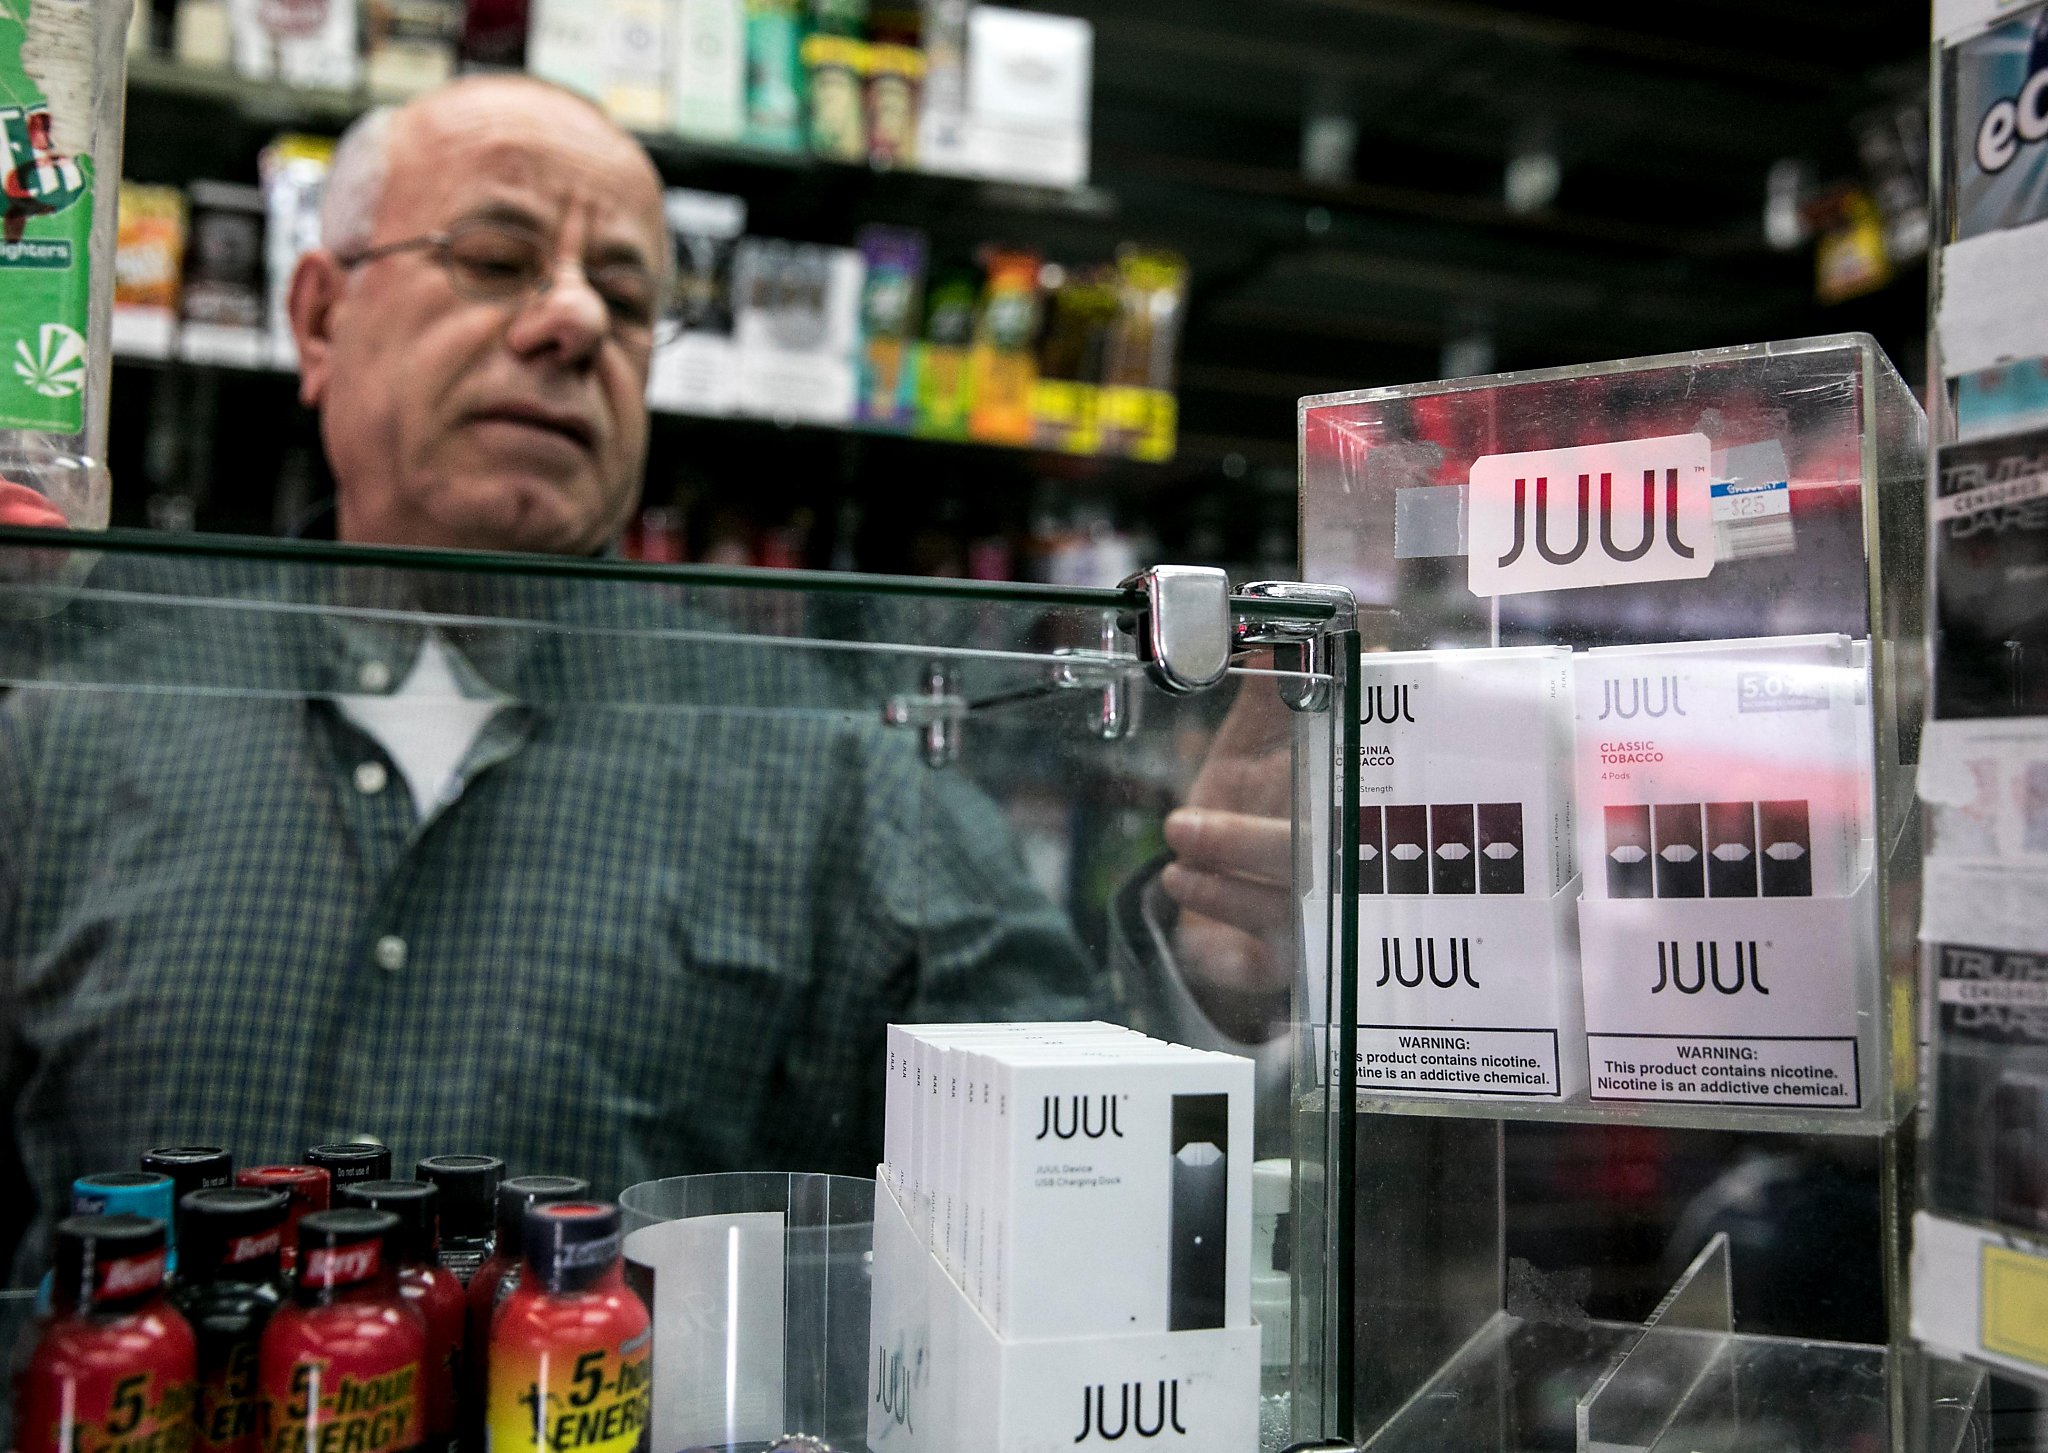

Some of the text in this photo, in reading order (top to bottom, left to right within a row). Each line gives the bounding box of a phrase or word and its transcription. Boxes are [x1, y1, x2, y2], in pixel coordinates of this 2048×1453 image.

[1731, 495, 1766, 516] $25
[1498, 467, 1695, 569] JUUL
[1360, 684, 1415, 725] UUL
[1599, 675, 1686, 721] JUUL
[1360, 745, 1391, 756] GINIA
[1600, 741, 1655, 752] CLASSIC
[1361, 756, 1395, 767] ACCO
[1600, 752, 1664, 765] TOBACCO
[1601, 771, 1630, 781] 4 Pods
[1360, 784, 1394, 795] Strength
[1376, 937, 1480, 989] JUUL
[1651, 940, 1769, 995] JUUL
[1398, 1036, 1470, 1051] WARNING:
[1366, 1051, 1418, 1068] product
[1420, 1053, 1478, 1068] contains
[1481, 1055, 1541, 1069] nicotine.
[1677, 1045, 1758, 1061] WARNING:
[1385, 1067, 1397, 1080] is
[1400, 1070, 1416, 1081] an
[1419, 1069, 1481, 1084] addictive
[1483, 1071, 1550, 1086] chemical.
[1604, 1060, 1838, 1080] This product contains nicotine.
[1597, 1076, 1849, 1097] Nicotine is an addictive chemical.
[1036, 1095, 1123, 1140] JUUL
[337, 1167, 345, 1178] Do
[345, 1167, 355, 1177] not
[355, 1167, 366, 1176] use
[1062, 1164, 1093, 1174] Device
[1035, 1175, 1121, 1188] USB Charging Dock
[876, 1345, 913, 1436] JUUL
[1074, 1378, 1187, 1444] JUUL
